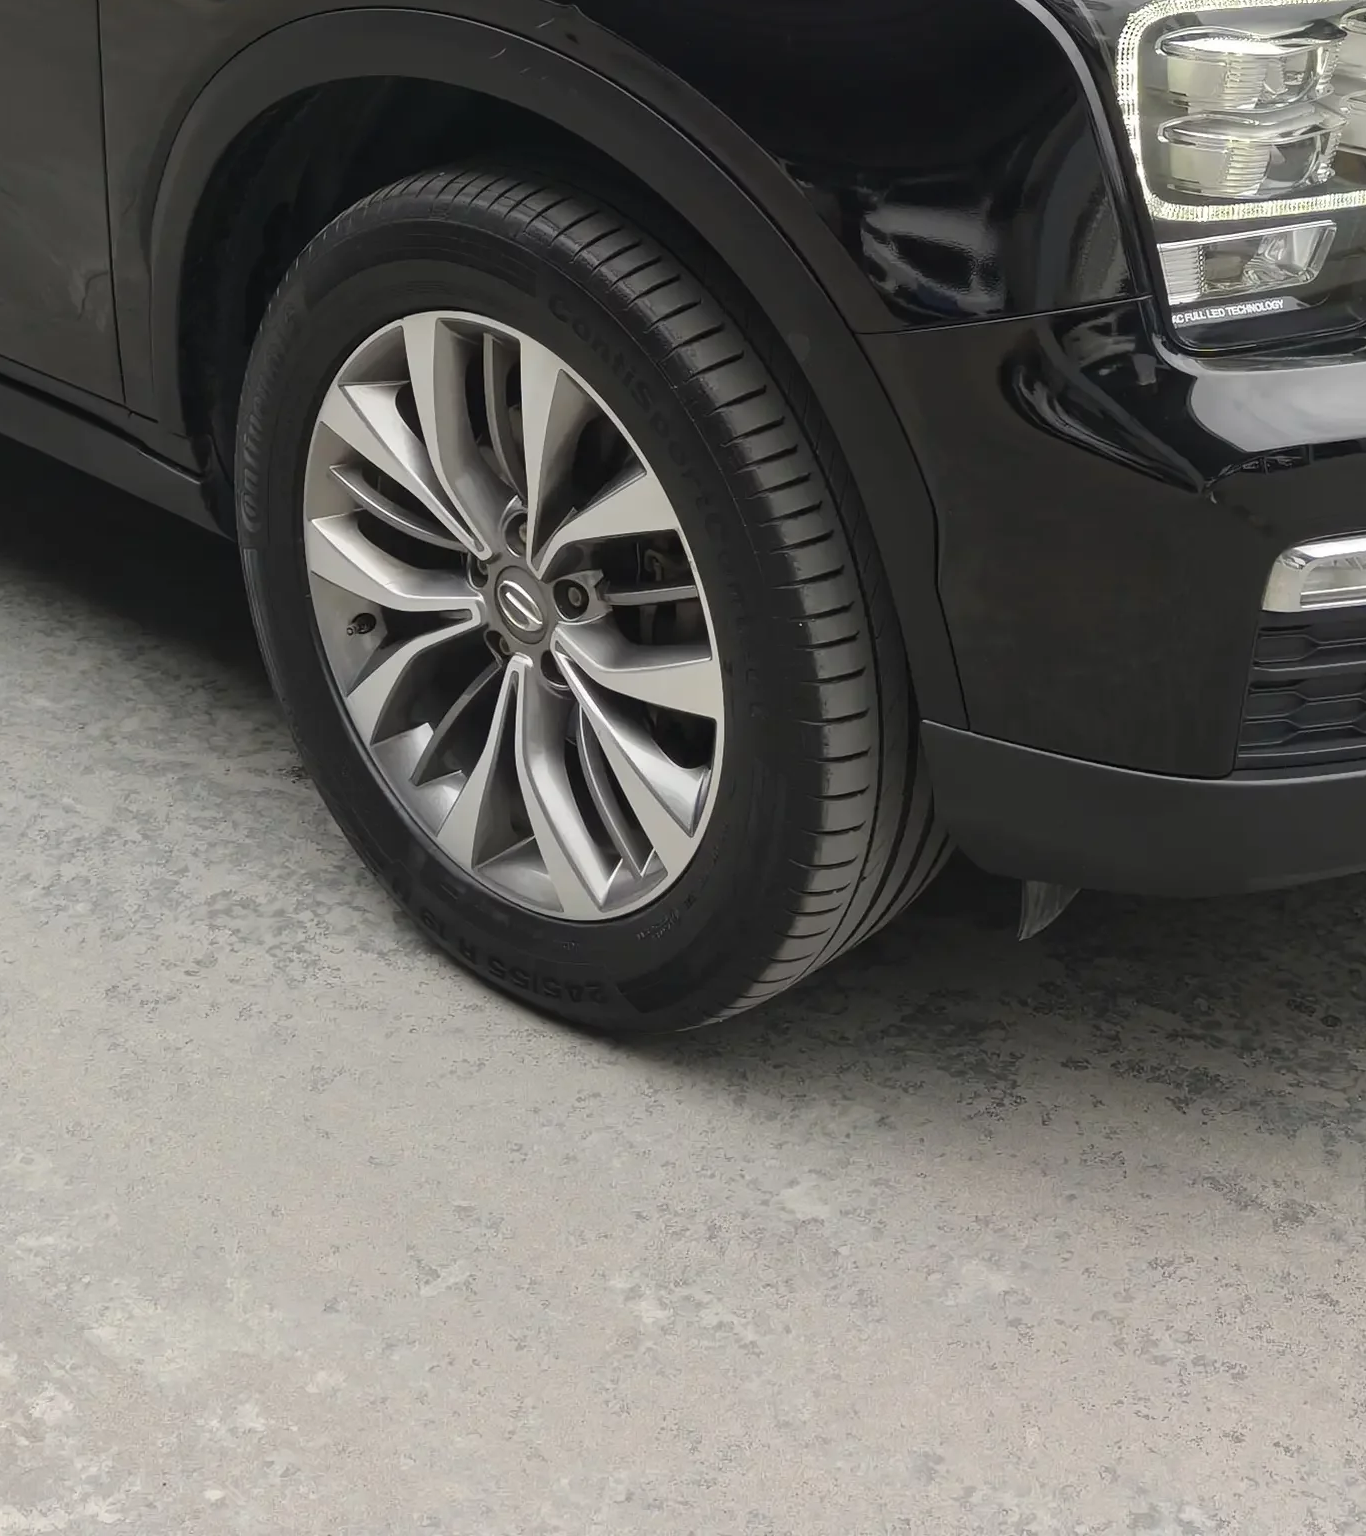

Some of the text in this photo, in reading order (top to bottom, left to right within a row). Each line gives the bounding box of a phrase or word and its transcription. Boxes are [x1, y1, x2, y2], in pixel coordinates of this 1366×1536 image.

[1185, 312, 1207, 323] FULL
[1207, 308, 1226, 319] LED
[1225, 299, 1284, 317] TECHNOLOGY
